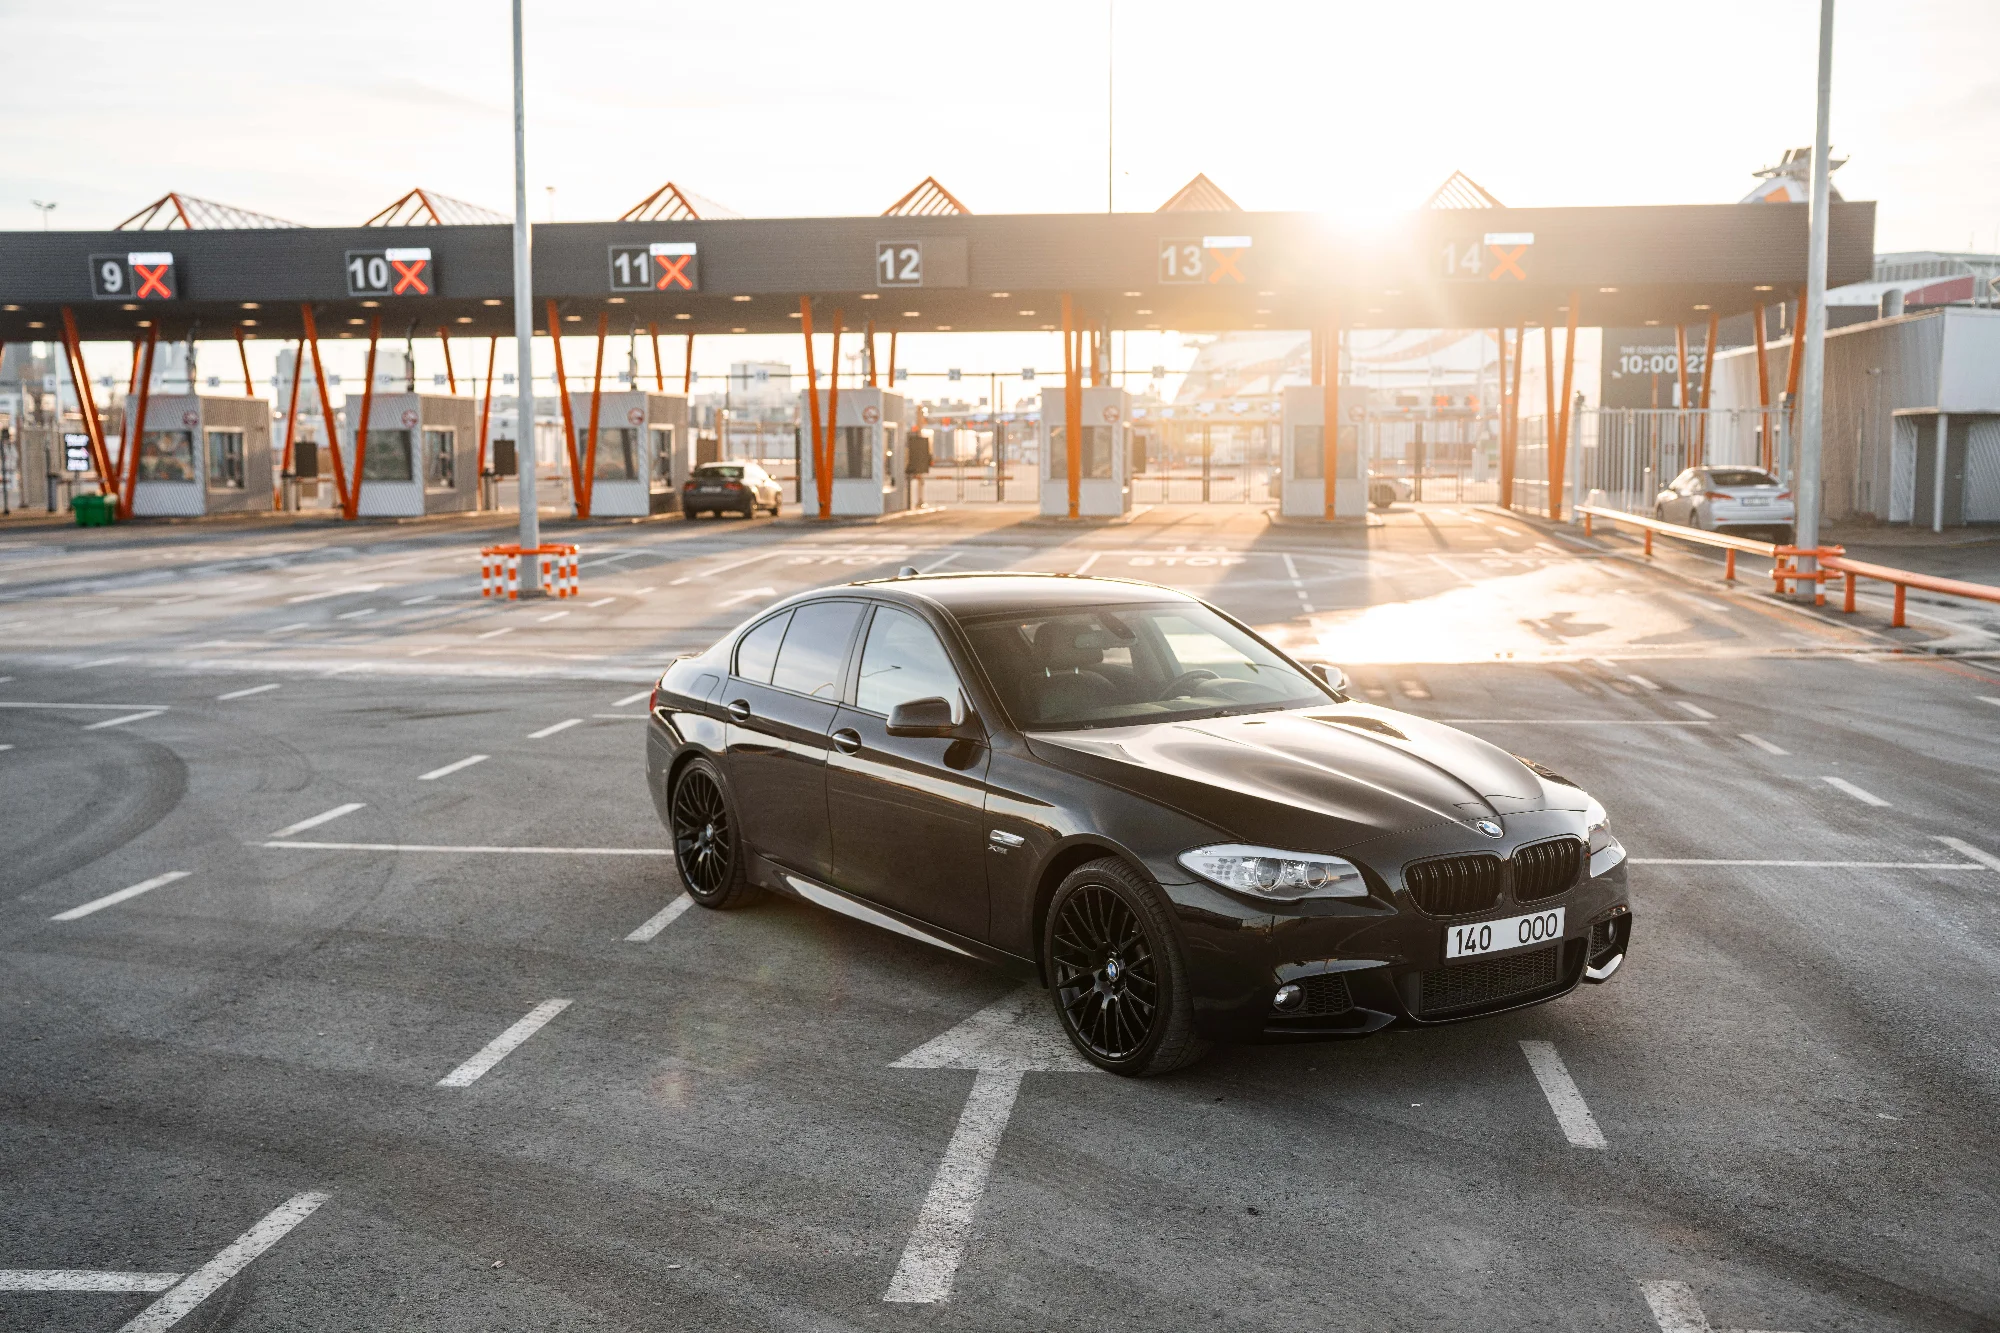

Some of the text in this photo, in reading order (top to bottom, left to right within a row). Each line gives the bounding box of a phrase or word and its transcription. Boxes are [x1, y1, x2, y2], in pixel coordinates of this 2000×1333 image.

[349, 257, 388, 289] 10
[614, 252, 649, 284] 11
[879, 248, 920, 280] 12
[1161, 245, 1202, 276] 13
[1441, 240, 1482, 274] 14
[102, 261, 122, 292] 9
[1128, 556, 1247, 567] STOP
[1456, 912, 1558, 955] 140 000
